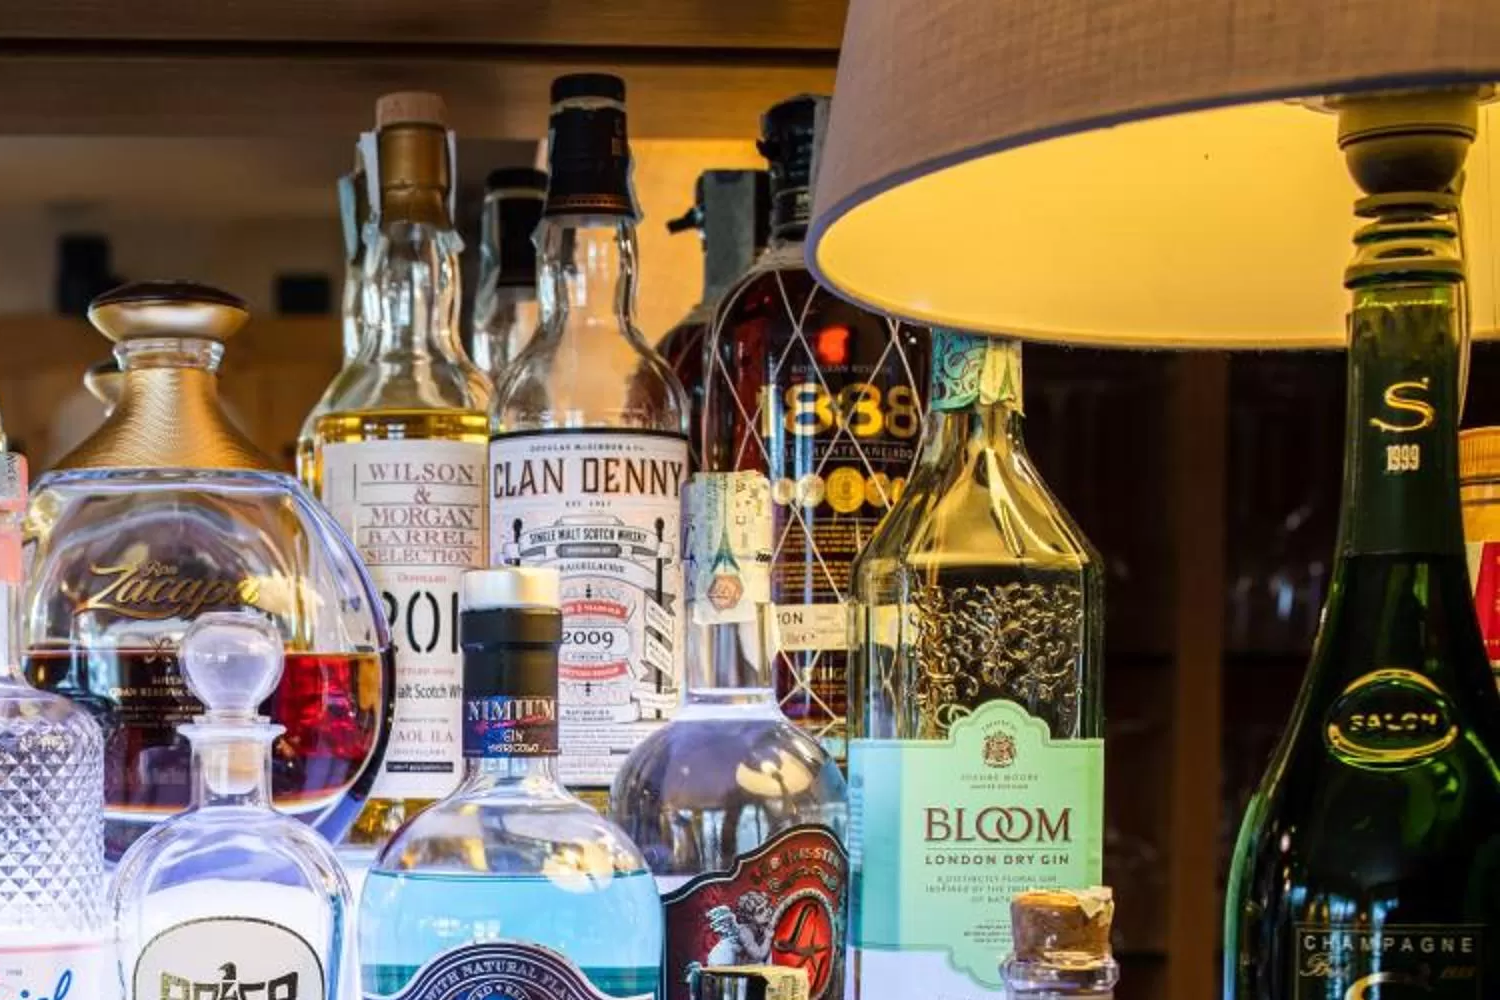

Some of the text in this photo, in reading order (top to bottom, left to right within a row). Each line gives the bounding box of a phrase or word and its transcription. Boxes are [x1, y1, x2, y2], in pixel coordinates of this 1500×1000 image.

[756, 383, 918, 438] 1888
[1369, 377, 1436, 432] S
[368, 463, 475, 483] WILSON
[493, 457, 683, 499] CLAN DENNY
[412, 487, 432, 505] &
[370, 507, 476, 529] MORGAN
[367, 529, 473, 546] BARREL
[529, 528, 647, 545] SINGLE MALT SCOTCH WHISKY
[365, 549, 473, 565] SELECTION
[562, 631, 614, 650] 2009
[1350, 713, 1438, 732] SALON
[924, 806, 1073, 844] BLOOM
[925, 854, 1070, 866] LONDON DRY GIN
[1303, 935, 1474, 954] CHAMPAGNE
[462, 960, 537, 980] NATURAL
